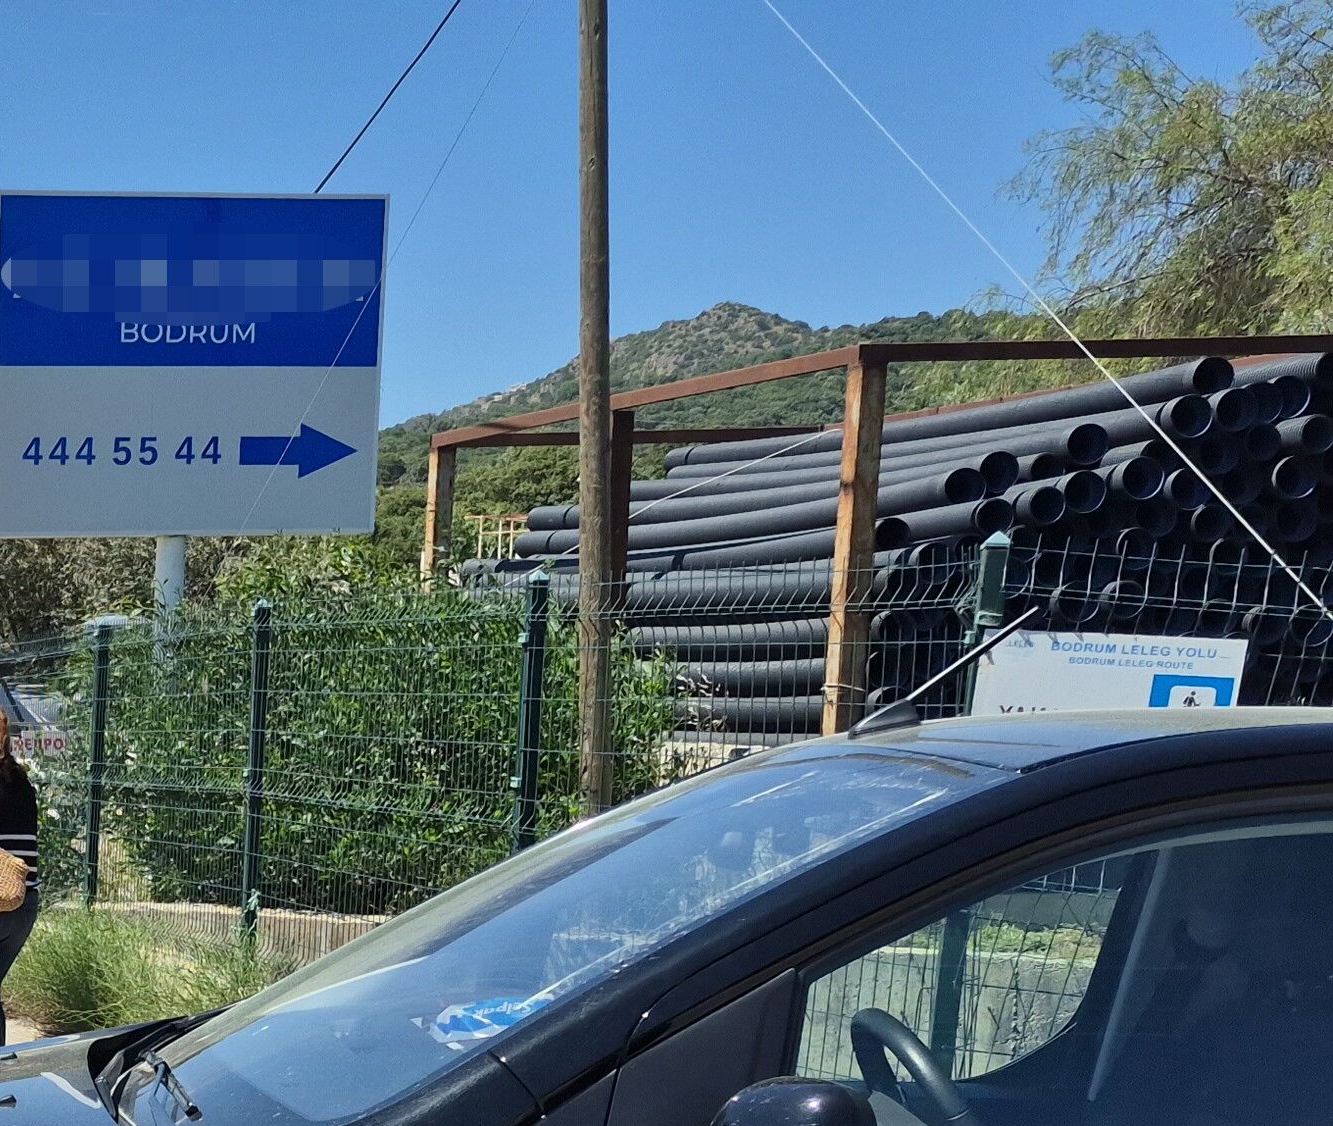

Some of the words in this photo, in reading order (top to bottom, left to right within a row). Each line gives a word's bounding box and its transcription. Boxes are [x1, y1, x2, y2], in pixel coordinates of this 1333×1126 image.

[120, 321, 256, 344] BODRUM
[21, 436, 96, 466] 444
[111, 436, 159, 466] 55
[174, 435, 222, 465] 44
[1050, 640, 1117, 655] BODRUM
[1120, 644, 1171, 657] LELEG
[1176, 647, 1217, 659] YOLU
[1068, 656, 1116, 666] BODRUM
[1118, 658, 1155, 668] LELEG
[1156, 660, 1194, 670] ROUTE
